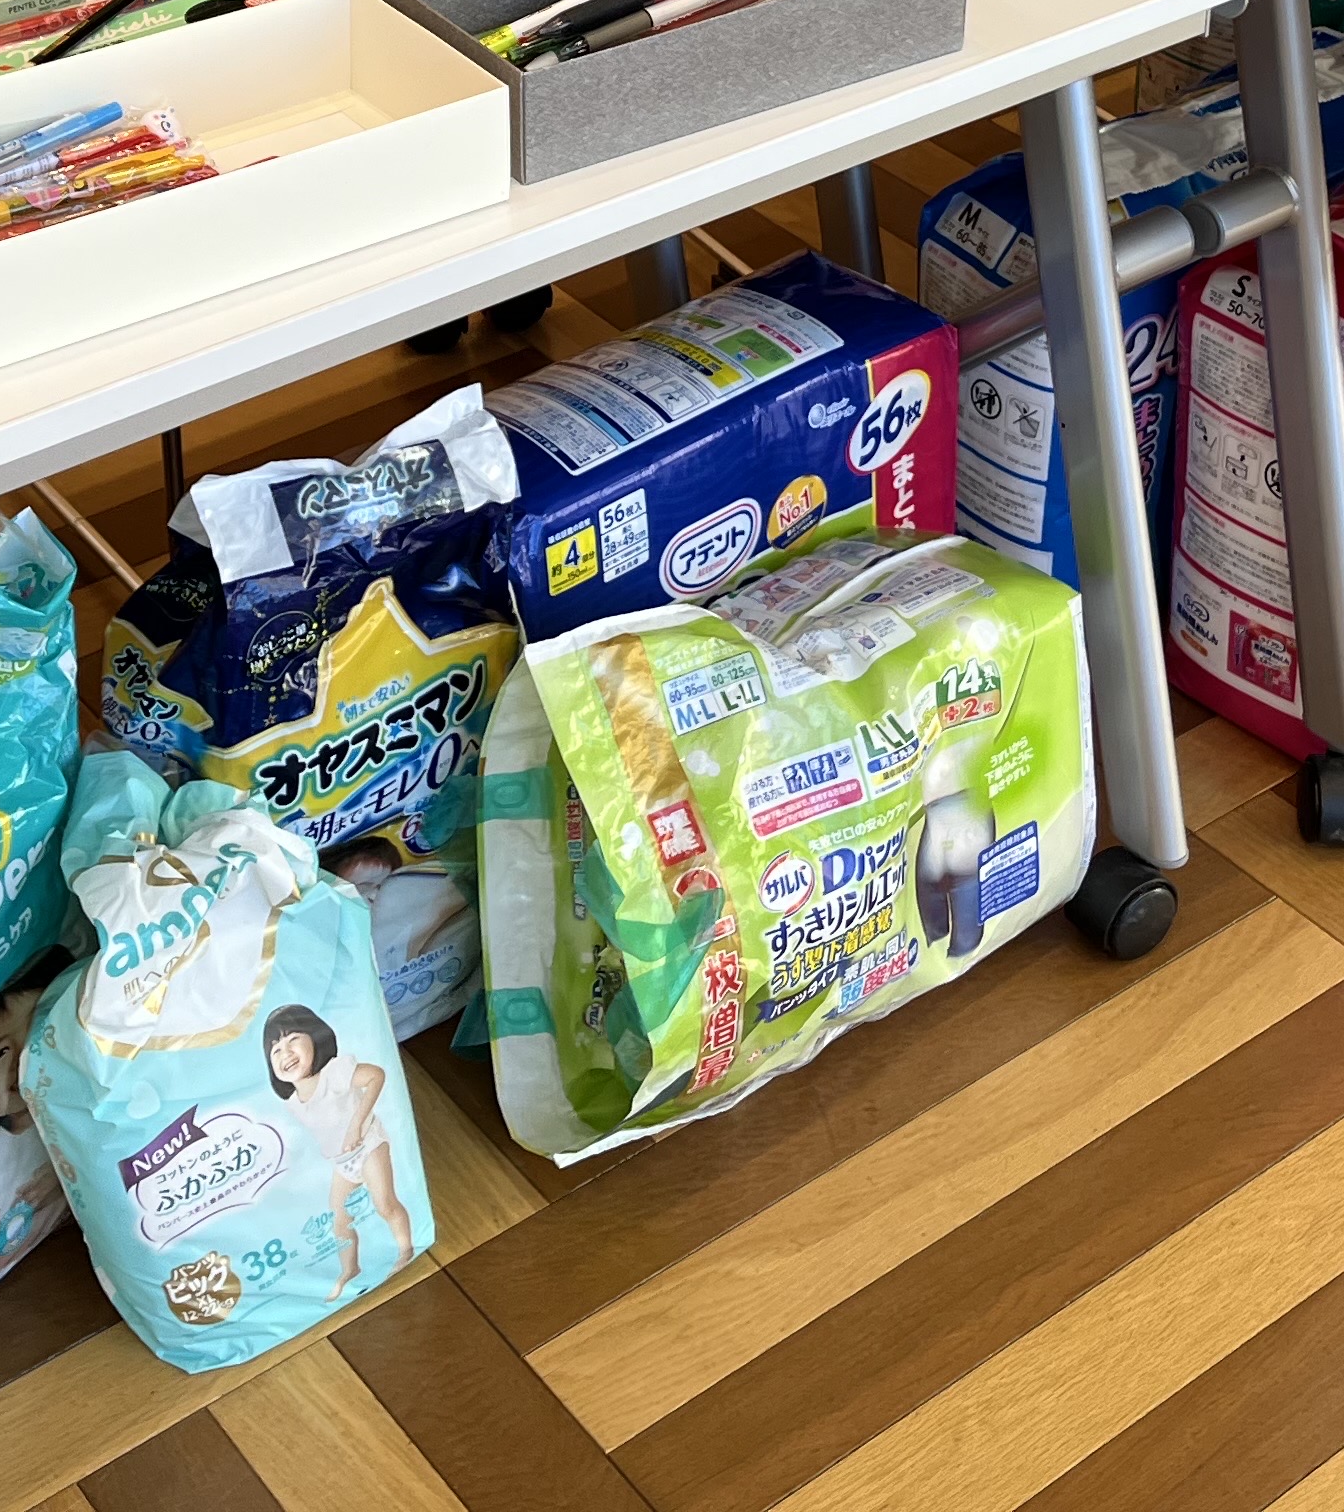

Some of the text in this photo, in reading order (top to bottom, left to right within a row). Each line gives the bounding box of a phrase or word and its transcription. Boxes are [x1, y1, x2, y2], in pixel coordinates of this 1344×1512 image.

[958, 201, 981, 232] M
[1231, 274, 1251, 299] S
[858, 398, 923, 465] 56枚
[603, 501, 645, 530] 56枚入
[777, 485, 813, 530] No.1
[679, 526, 747, 577] アテント
[257, 659, 487, 807] オヤスミマン
[763, 863, 809, 904] サルバ
[820, 825, 908, 897] Dパンツ
[765, 851, 909, 962] すっきりシルエット
[771, 907, 895, 992] うす型下着感覚
[768, 961, 841, 1020] パンツタイプ
[839, 948, 911, 1012] 弱酸性
[129, 1122, 195, 1179] New!
[154, 1129, 244, 1187] コットンのように
[155, 1140, 263, 1216] ふかふか
[164, 1265, 232, 1306] ビッグ
[171, 1252, 218, 1282] パンツ
